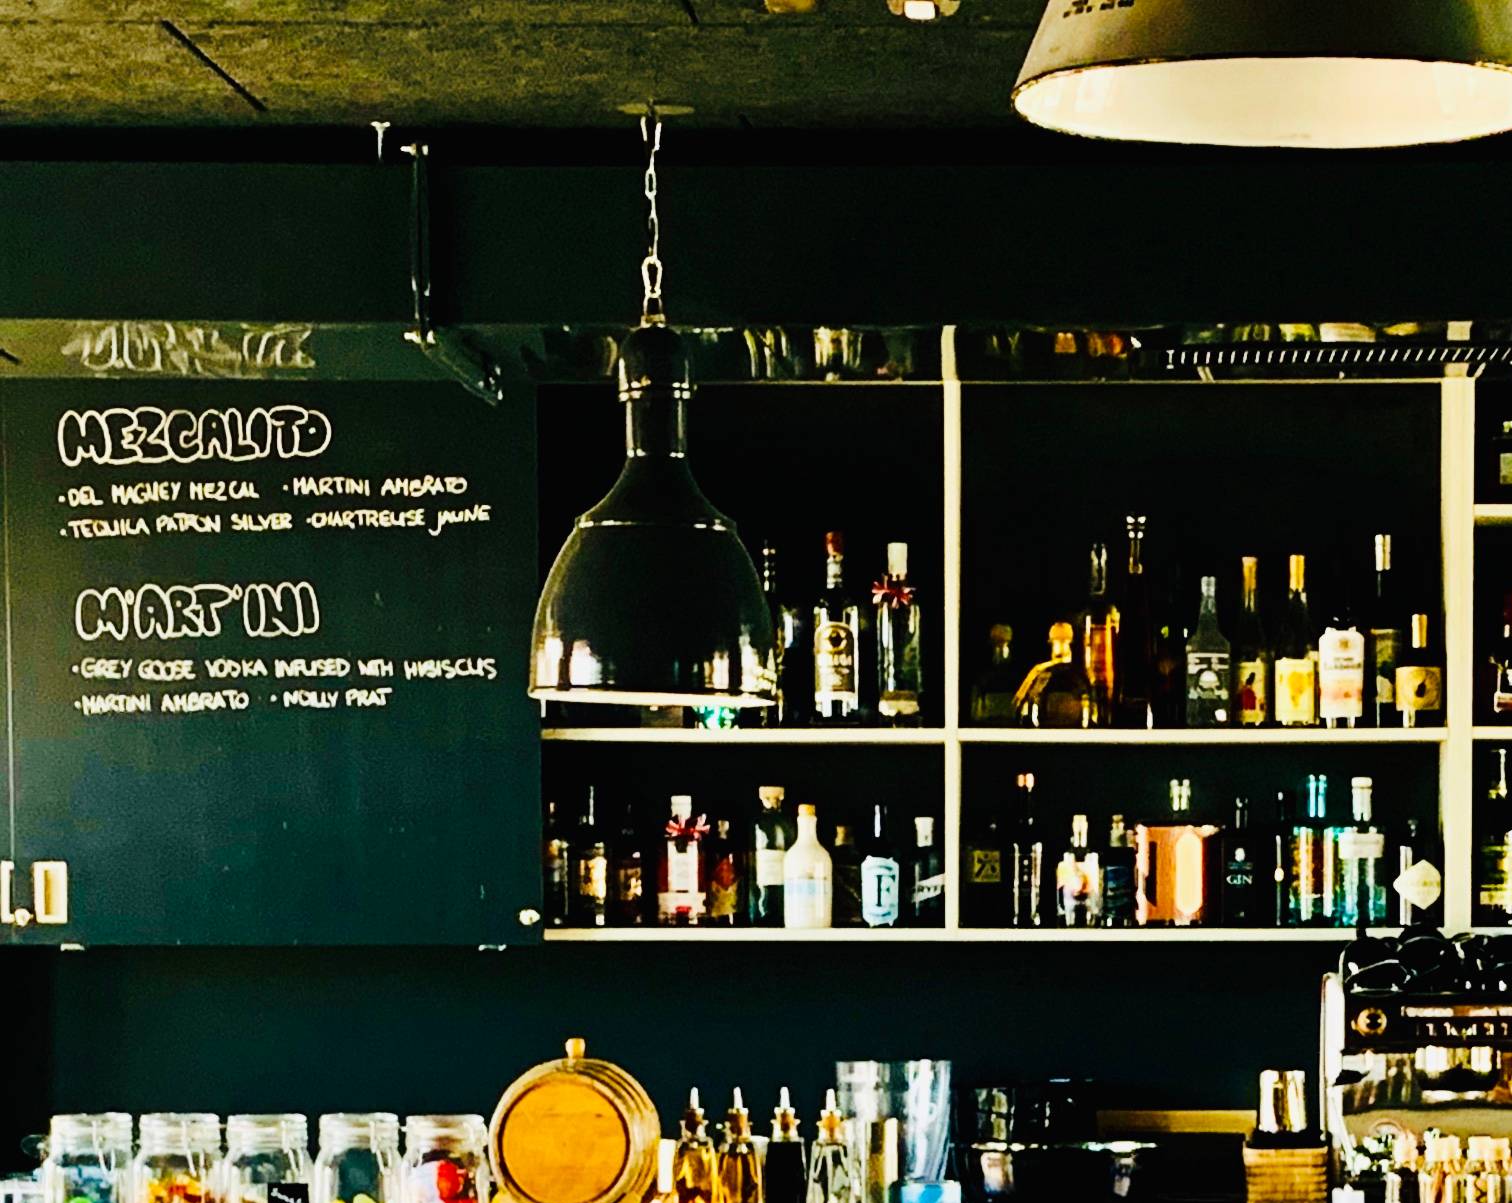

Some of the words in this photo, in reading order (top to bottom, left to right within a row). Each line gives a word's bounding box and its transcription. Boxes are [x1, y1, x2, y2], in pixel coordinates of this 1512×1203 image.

[57, 404, 332, 467] MEZCALITO
[67, 485, 104, 507] DEL
[293, 476, 371, 497] MARTINI
[380, 474, 468, 498] AMBRATO
[67, 517, 151, 539] TEQUILA
[155, 512, 221, 533] PATRON
[230, 512, 293, 532] SILVER
[428, 504, 492, 537] JAUNE
[80, 657, 133, 680] GREY
[137, 659, 196, 682] GOOSE
[204, 658, 268, 678] VODKA
[274, 657, 351, 679] INFUSED
[403, 657, 498, 681] HIBISCUS
[81, 693, 151, 716] MARTINI
[160, 689, 250, 713] AMBRATO
[345, 687, 393, 707] PRAT
[1225, 873, 1253, 886] GIN
